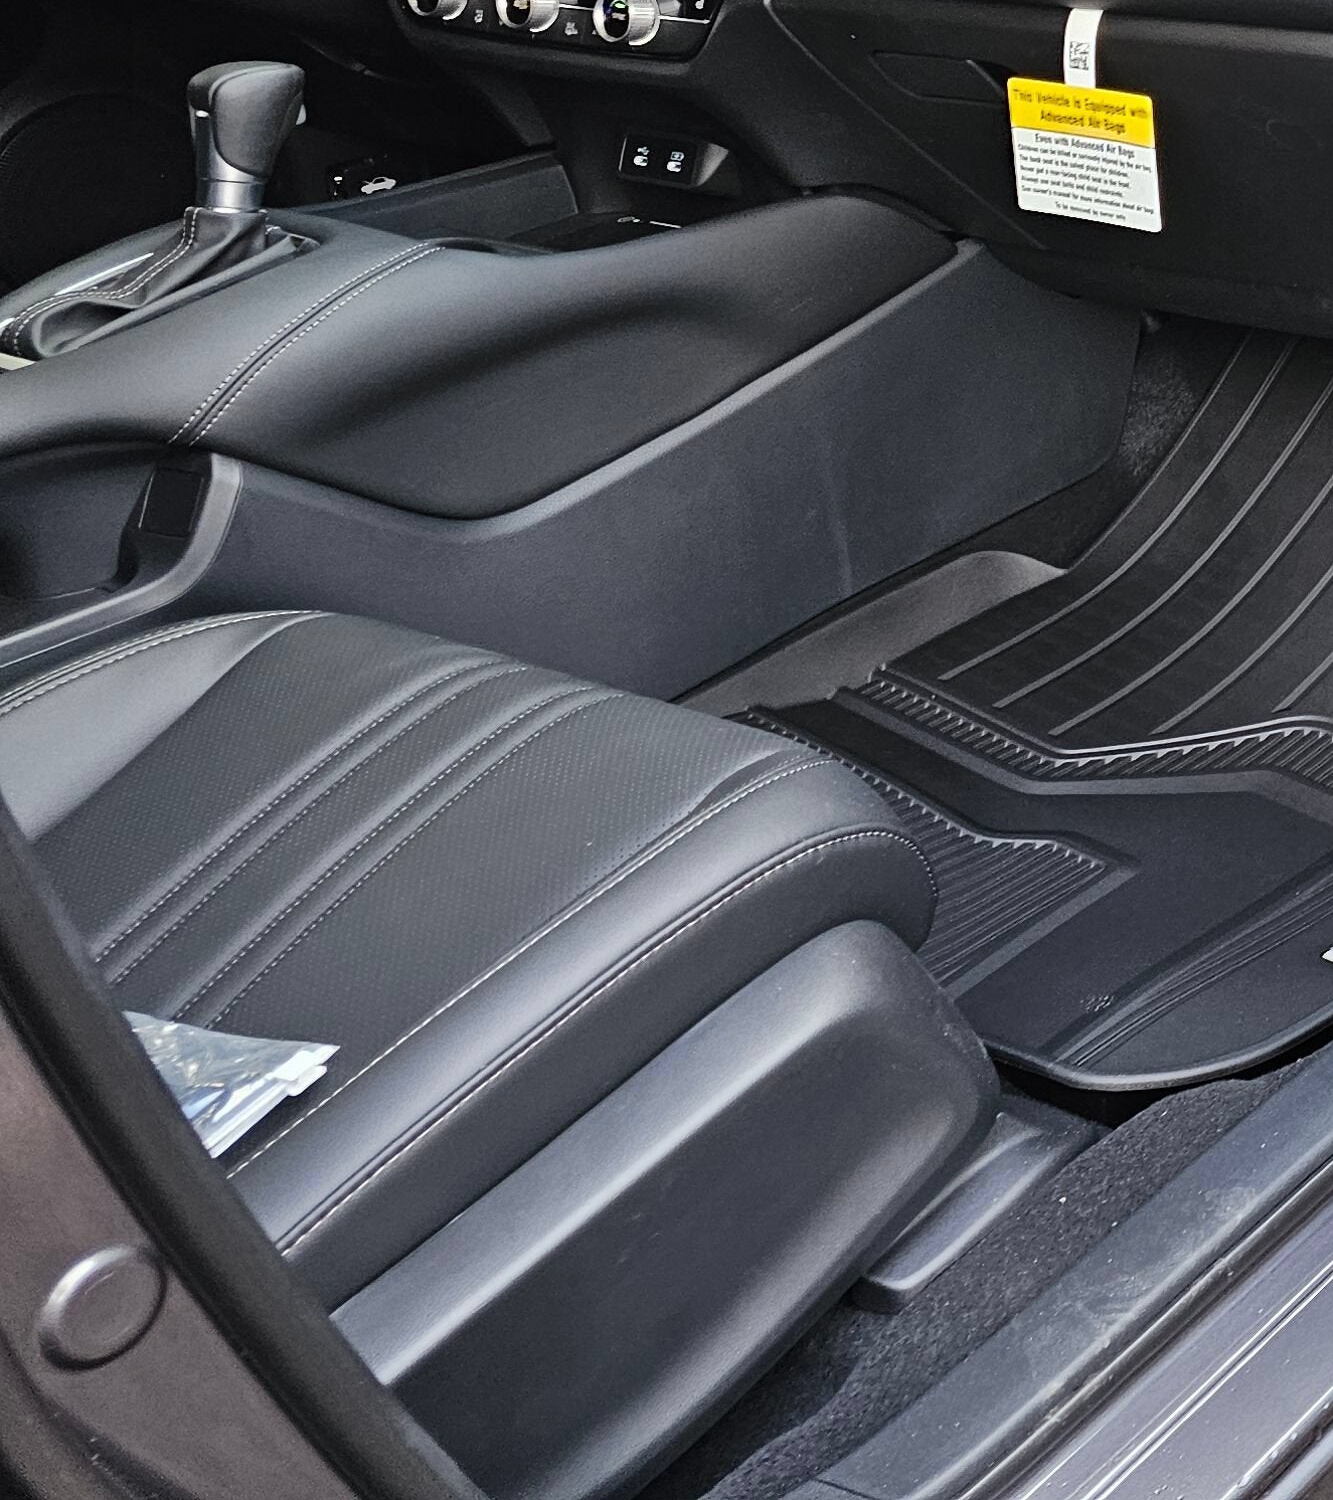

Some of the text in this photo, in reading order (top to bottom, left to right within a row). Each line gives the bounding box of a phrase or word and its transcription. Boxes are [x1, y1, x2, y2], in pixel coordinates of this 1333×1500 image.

[1037, 92, 1070, 107] Vehicle
[1084, 99, 1127, 117] Equipped
[1040, 110, 1126, 135] Advanced Air Bags
[1034, 133, 1135, 159] Even with Advanced Air Bags
